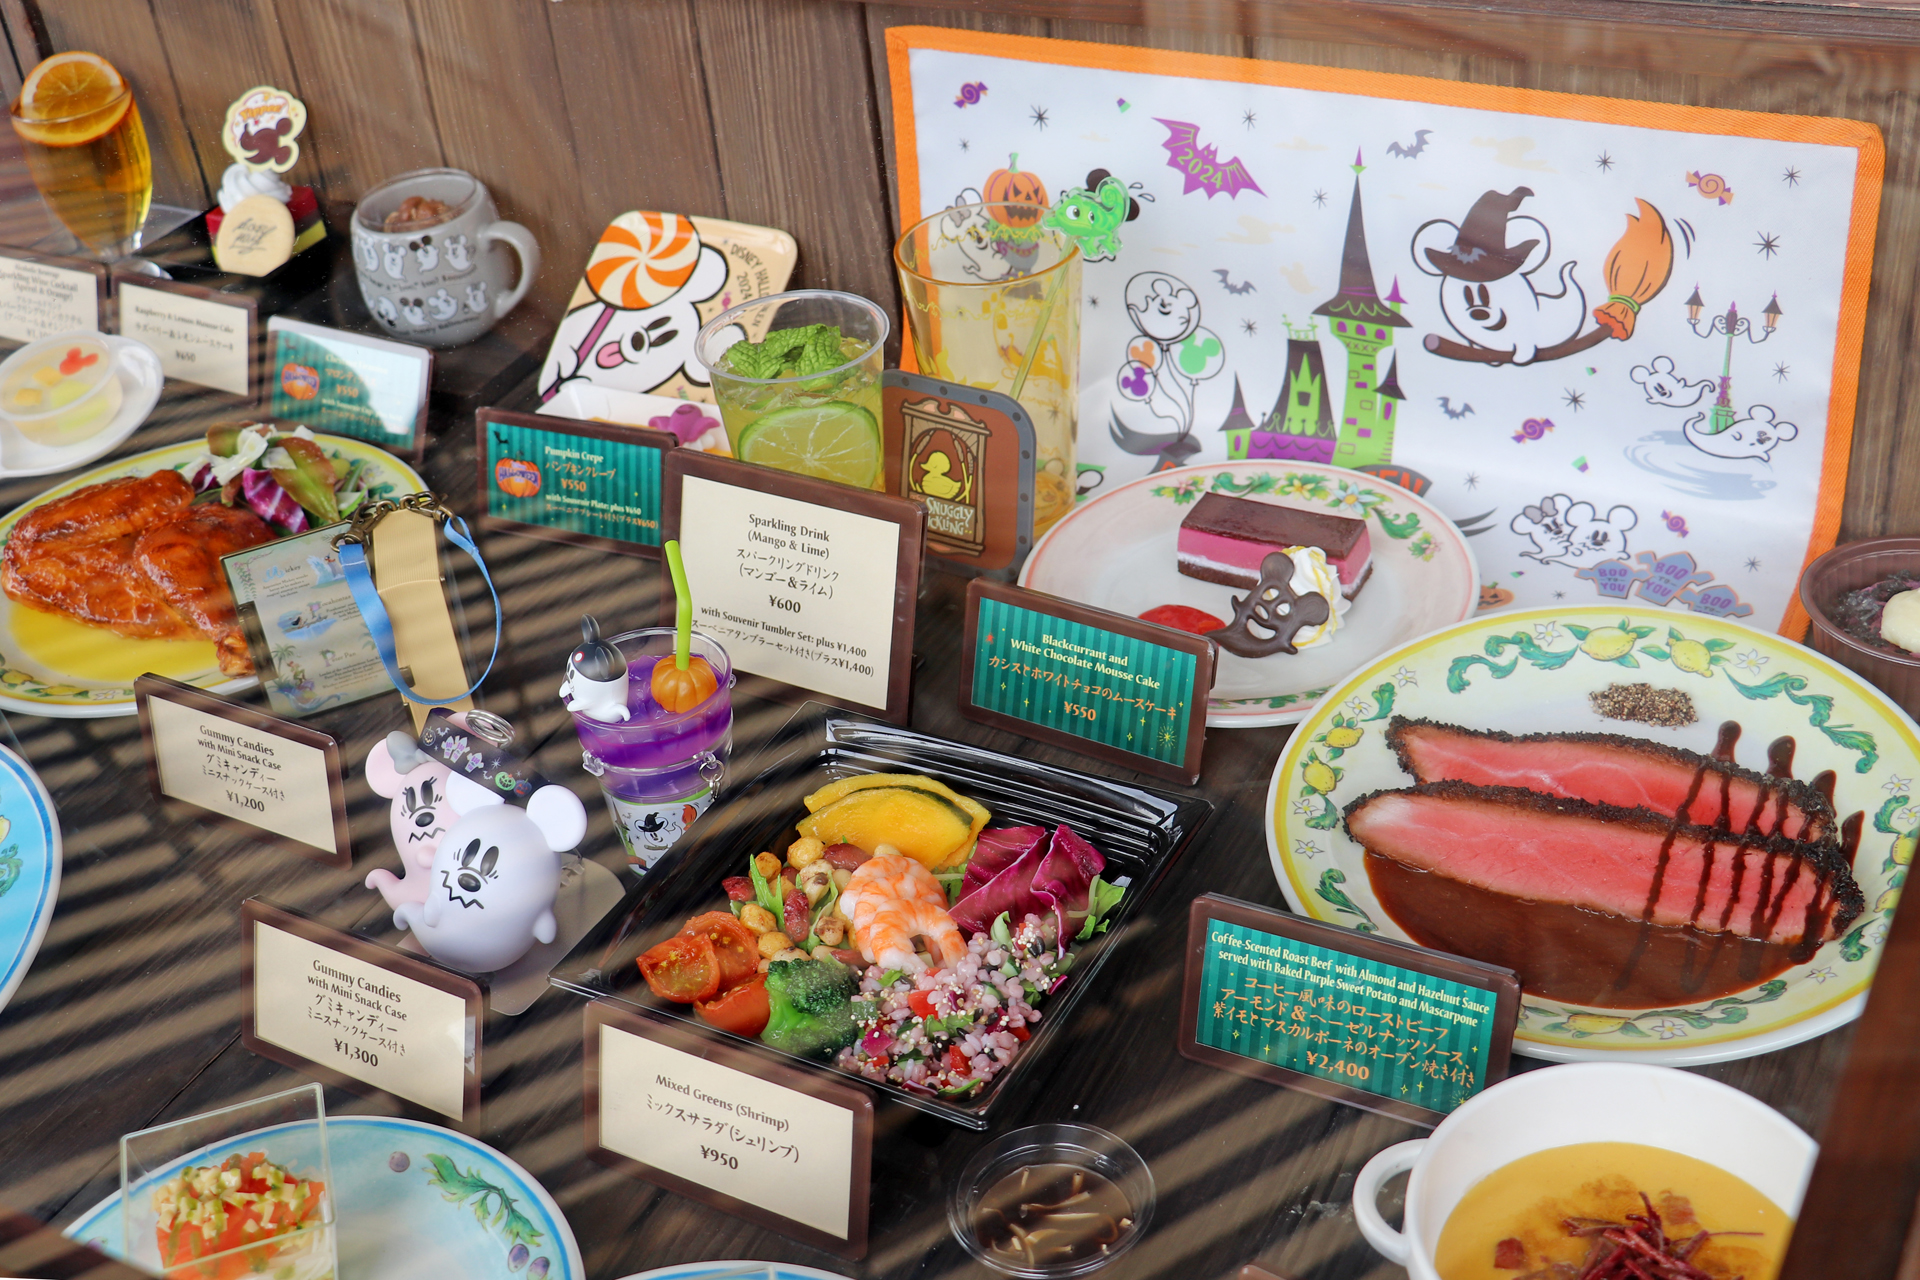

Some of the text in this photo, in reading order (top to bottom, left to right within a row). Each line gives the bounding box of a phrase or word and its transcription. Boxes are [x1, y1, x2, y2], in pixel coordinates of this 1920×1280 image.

[1177, 148, 1223, 188] 2024
[730, 244, 763, 269] DISNEY
[737, 272, 752, 300] 2024
[176, 350, 196, 362] ¥650
[336, 384, 359, 398] ¥550
[545, 446, 604, 464] Pumpkin Crepe
[545, 461, 616, 480] パンプキンクレープ
[561, 478, 586, 492] ¥550
[546, 493, 641, 515] with Souvenir Plate: plus ¥650
[926, 497, 974, 528] SNUGGLY
[749, 513, 830, 542] Sparkling Drink
[747, 529, 829, 560] (Mango & Lime)
[736, 548, 839, 582] スパークリングドリンク
[1598, 568, 1628, 577] BOO
[1654, 562, 1689, 580] BOO
[739, 563, 833, 599] (マンゴー&ライム)
[1601, 583, 1626, 592] YOU
[1646, 581, 1672, 597] YOU
[769, 595, 801, 613] ¥600
[1700, 593, 1732, 609] BOO
[701, 607, 867, 658] with Souvenir Tumbler Set: plus ¥1,400
[1011, 638, 1160, 689] White Chocolate Mousse Cake
[1042, 634, 1128, 666] Blackcurrant and
[988, 655, 1177, 721] カシスとホワイトチョコのムースケーキ
[1064, 701, 1096, 721] ¥550
[197, 738, 281, 771] with Mini Snack Case
[199, 725, 274, 756] Gummy Candies
[206, 753, 276, 782] グミキャンディー
[202, 765, 286, 801] ミニスナックケース付き
[226, 789, 265, 812] ¥1,200
[313, 960, 401, 1003] Gummy Candies
[1211, 931, 1490, 1014] Coffee-Scented Roast Beef with Almond and Hazelnut Sauce
[307, 975, 407, 1021] with Mini Snack Case
[1218, 949, 1478, 1028] served with Baked Purple Sweet Potato and Mascarpone
[315, 993, 398, 1033] グミキャンディー
[1244, 976, 1448, 1040] コーヒー風味のローストビーフ
[307, 1006, 406, 1056] ミニスナックケース付き
[334, 1038, 378, 1067] ¥1,300
[1306, 1051, 1370, 1080] ¥2,400
[655, 1073, 789, 1132] Mixed Greens (Shrimp)
[646, 1093, 800, 1163] ミックスサラダ(シュリンプ)
[700, 1144, 739, 1169] ¥950
